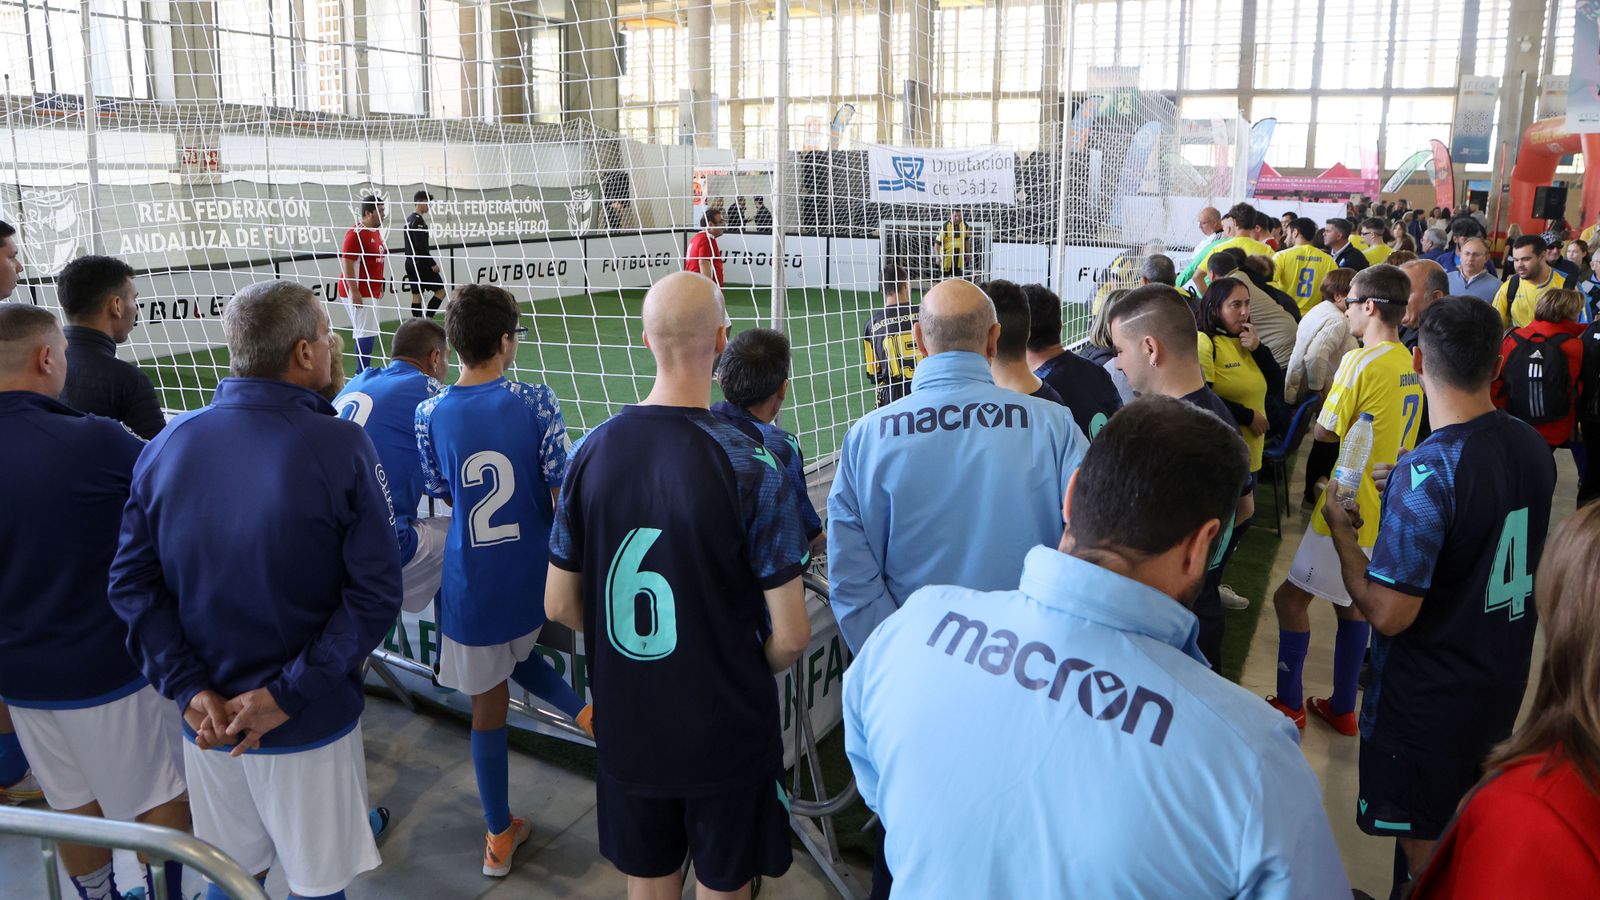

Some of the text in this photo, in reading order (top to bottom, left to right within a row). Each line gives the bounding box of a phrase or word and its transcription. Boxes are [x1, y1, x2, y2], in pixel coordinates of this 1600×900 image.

[932, 154, 1012, 175] Diputación
[933, 179, 998, 196] de Cádiz
[139, 197, 311, 223] REAL FEDERACIÓN
[430, 196, 541, 216] REAL FEDERACIÓN
[120, 223, 331, 254] ANDALUZA DE FÚTBOL
[429, 222, 487, 239] DALUZA
[489, 221, 506, 237] DE
[477, 260, 567, 284] FUTBOLEO
[603, 252, 670, 273] FUTBOLEO
[1297, 267, 1315, 298] 8
[879, 402, 1029, 439] macron
[1398, 394, 1420, 450] 7
[461, 451, 521, 548] 2
[1485, 507, 1533, 622] 4
[605, 527, 677, 661] 6
[926, 610, 1175, 747] macron
